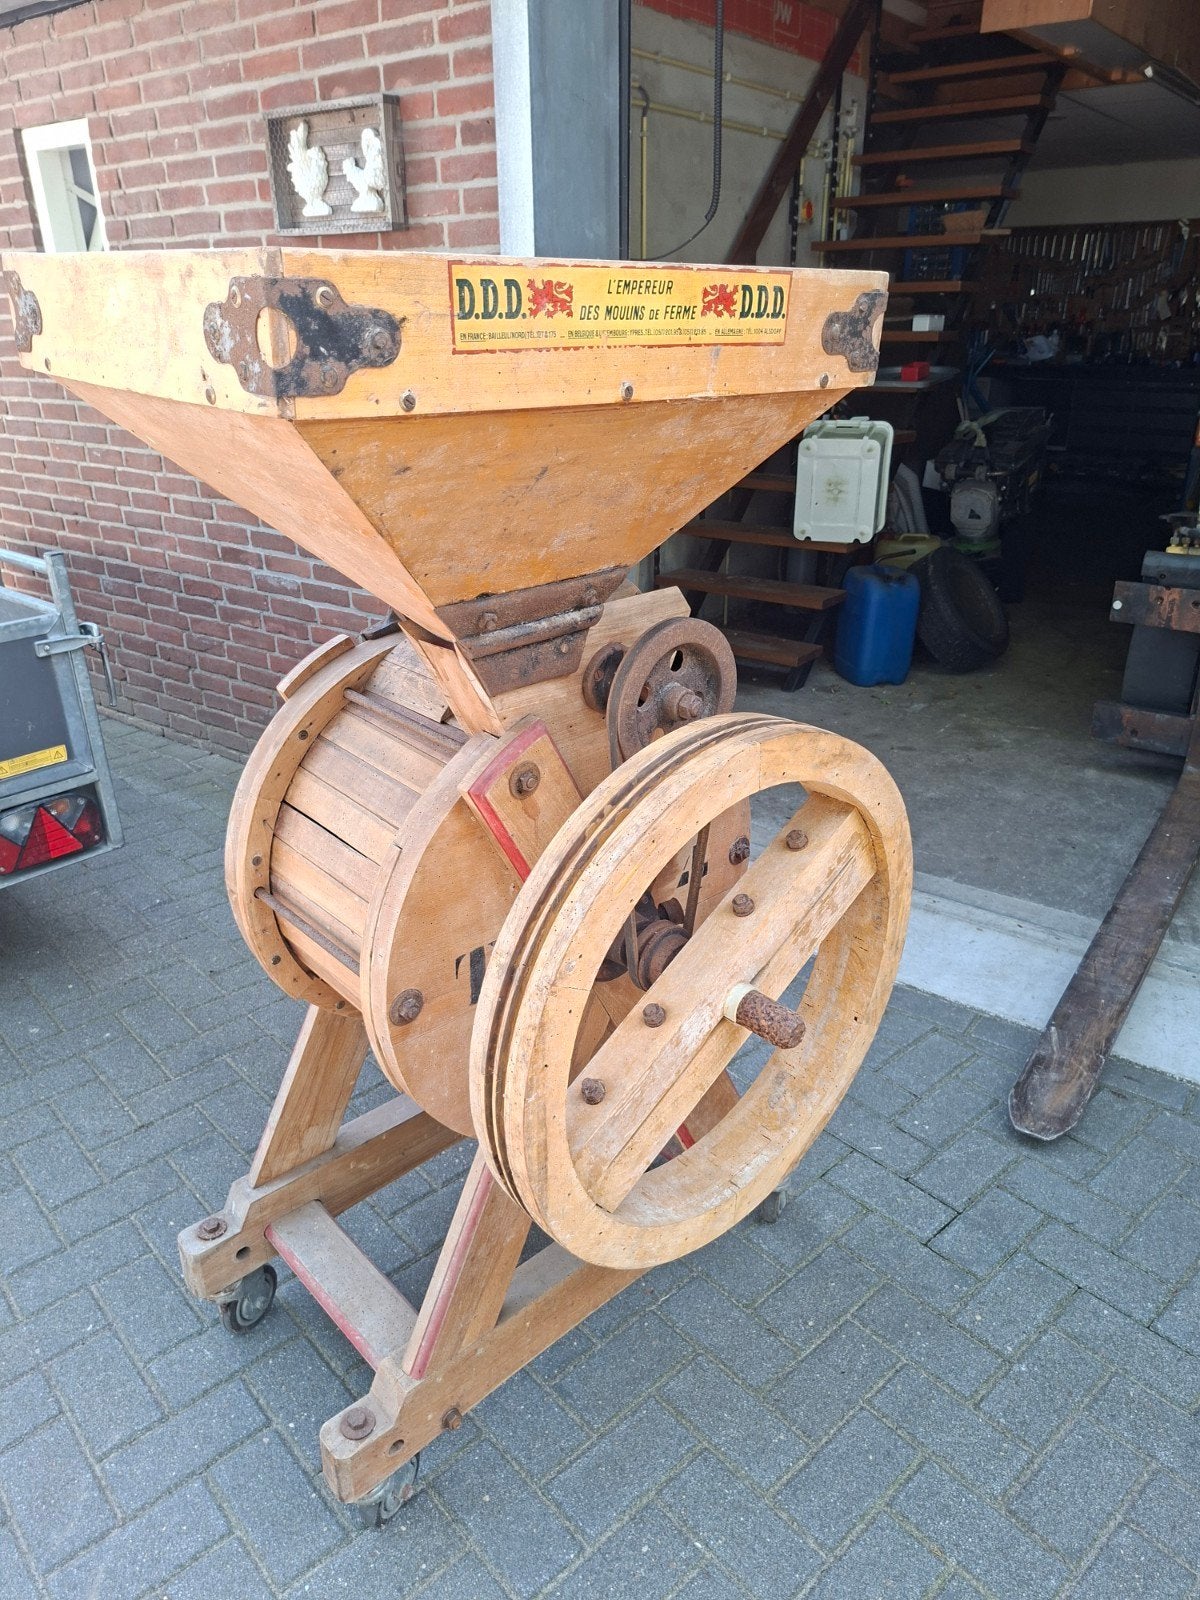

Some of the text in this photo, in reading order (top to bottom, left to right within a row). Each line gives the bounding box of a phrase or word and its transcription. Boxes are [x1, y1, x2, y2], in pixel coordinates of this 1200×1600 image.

[607, 279, 674, 295] L'EMPEREUR
[455, 278, 527, 320] D.D.D.
[739, 284, 786, 319] D.D.D.
[579, 305, 600, 321] DES
[604, 305, 646, 321] MOULINS
[663, 305, 698, 320] FERME
[460, 332, 467, 341] EN
